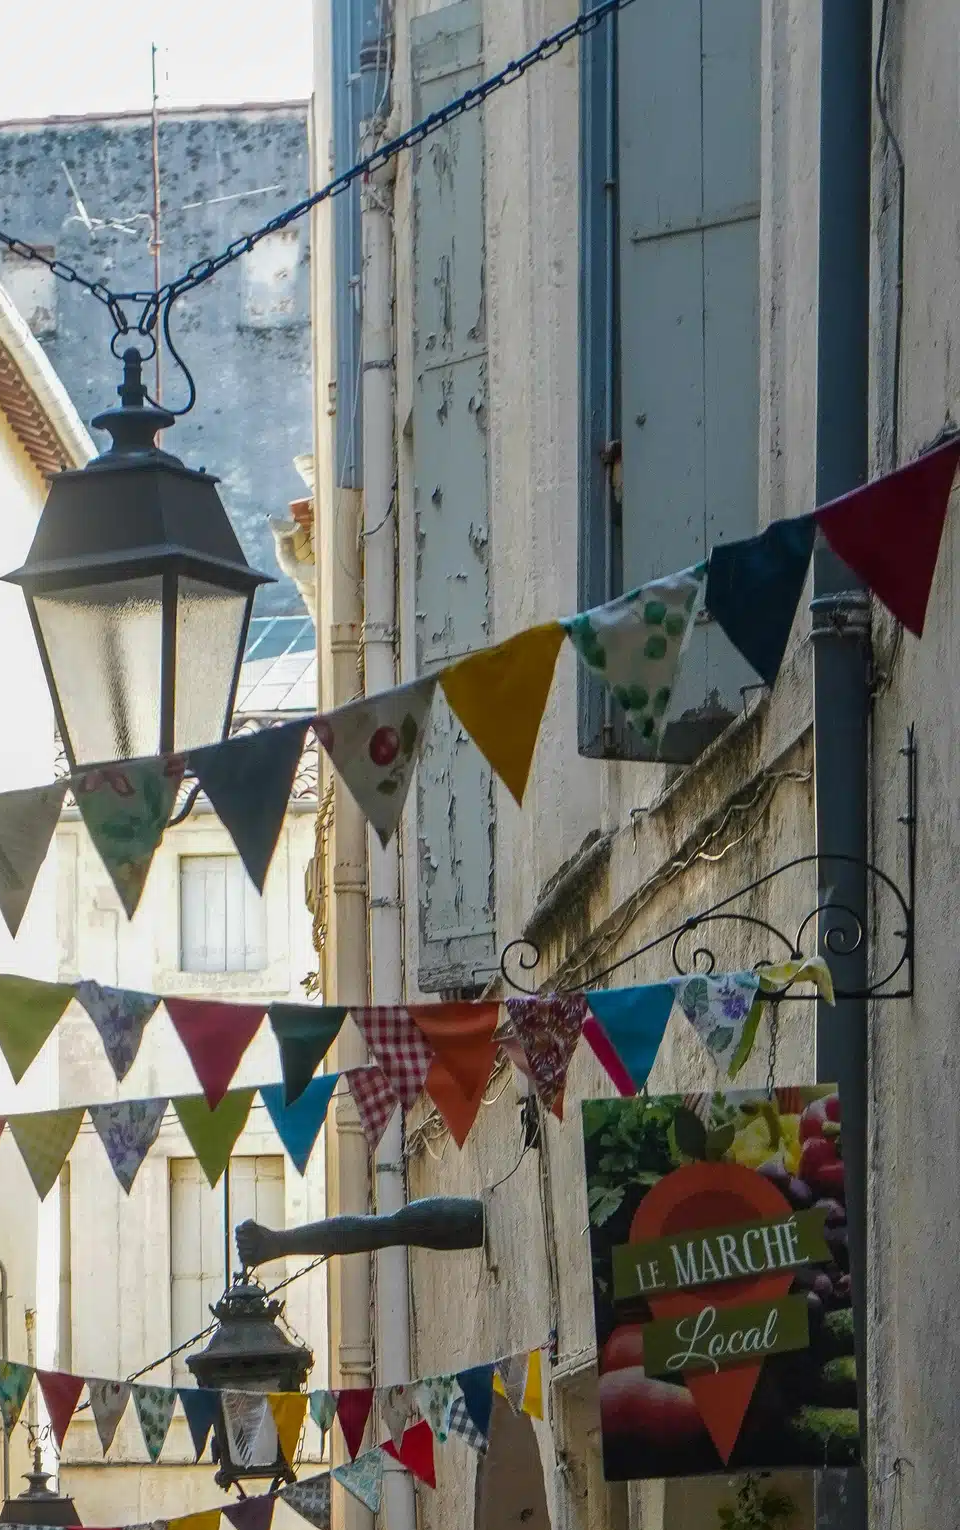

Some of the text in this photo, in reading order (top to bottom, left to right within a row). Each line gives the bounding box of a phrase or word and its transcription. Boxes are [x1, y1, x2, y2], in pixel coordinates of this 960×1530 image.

[636, 1216, 809, 1291] LE MARCHÉ
[666, 1306, 778, 1375] Local
